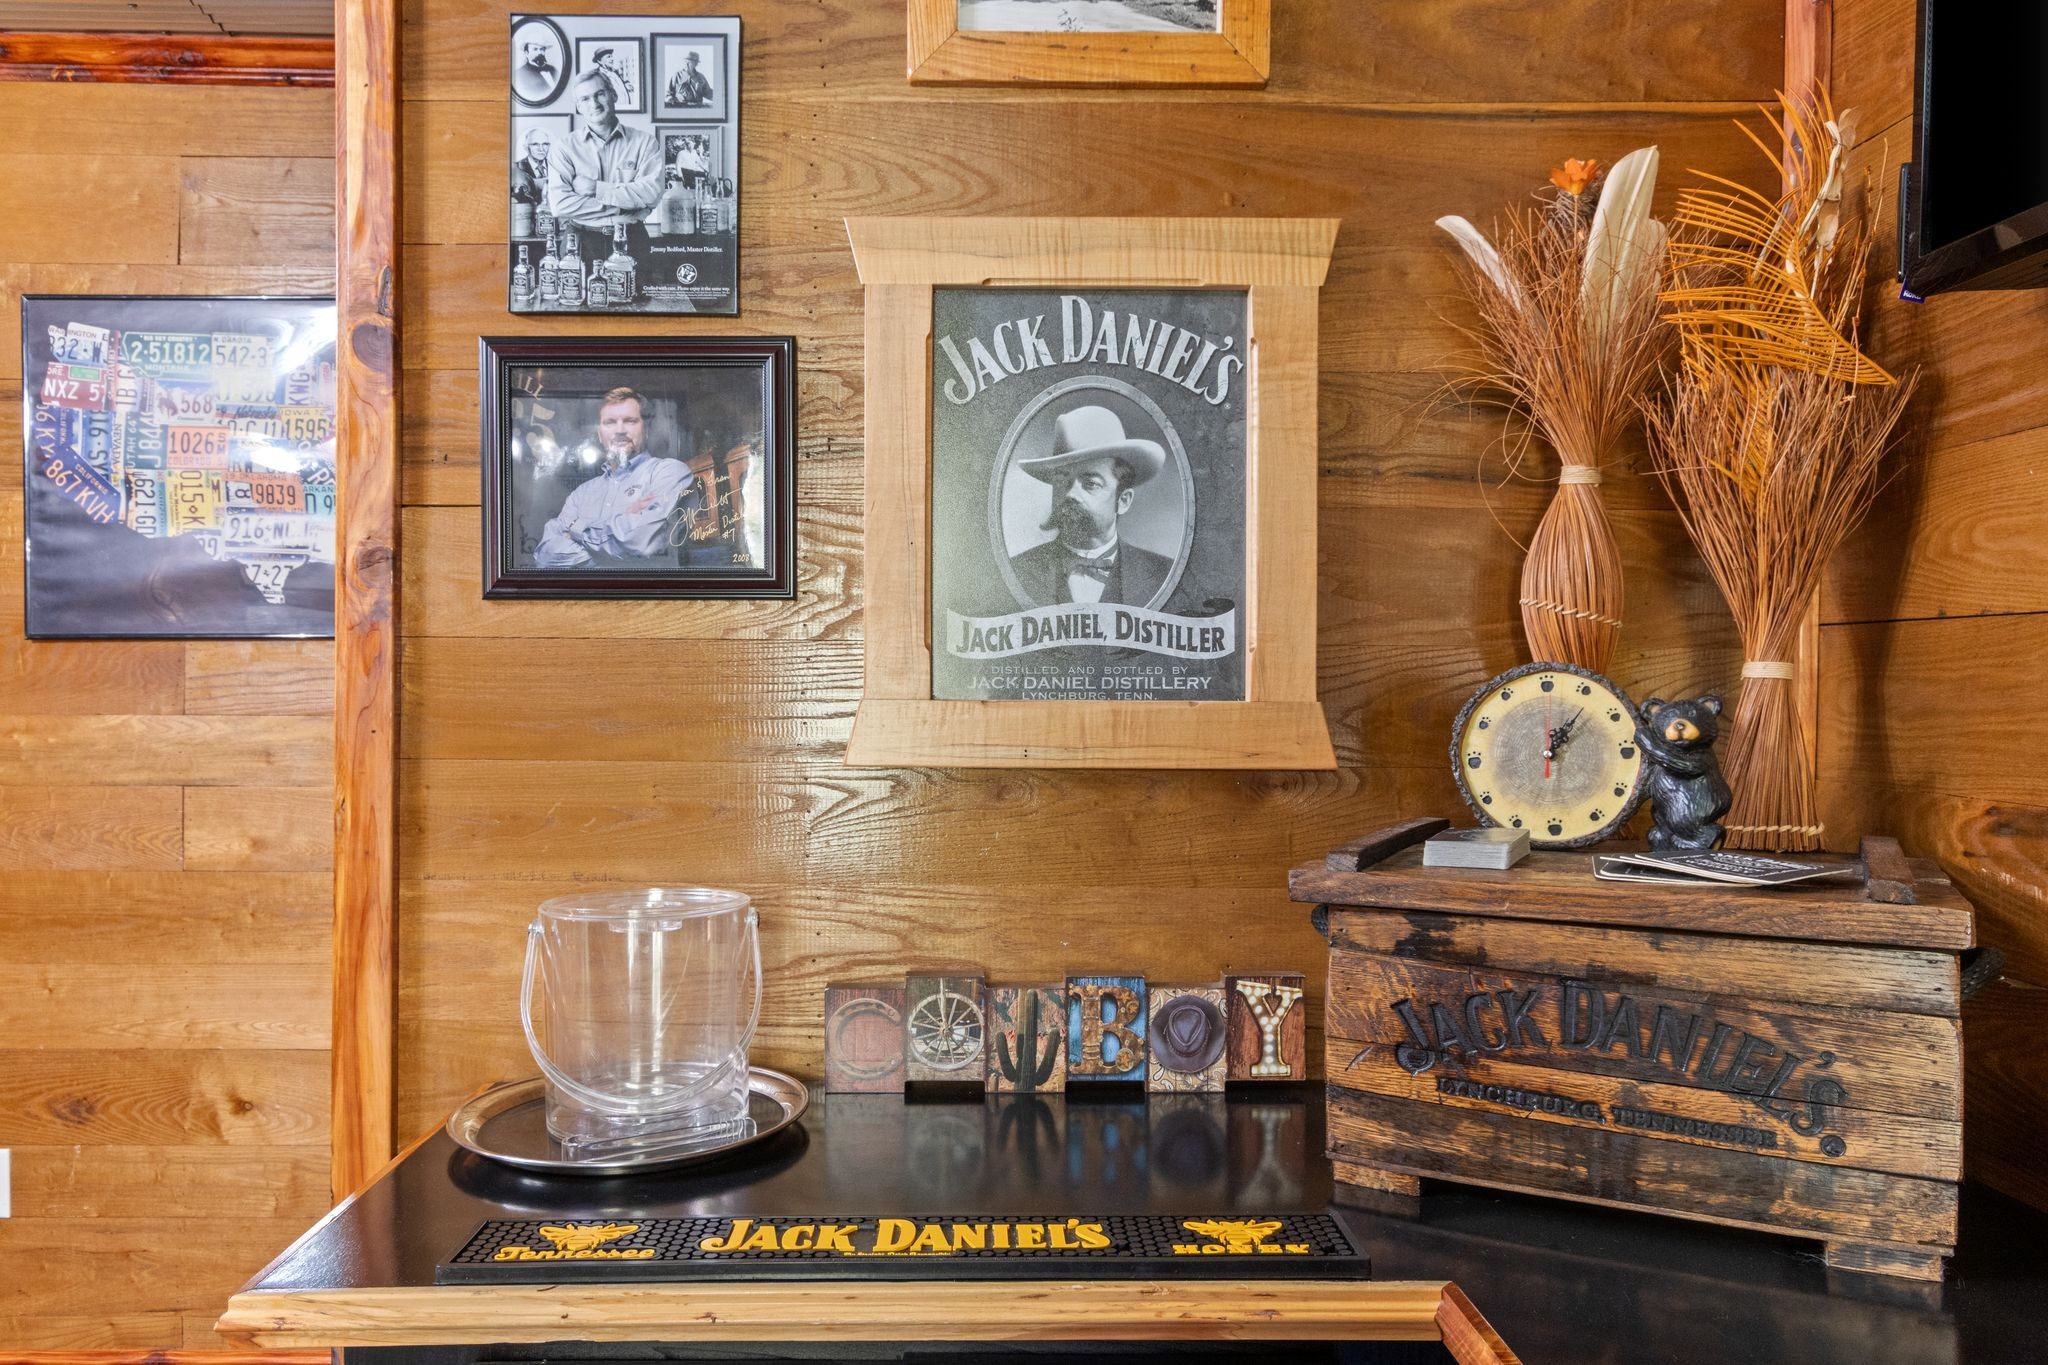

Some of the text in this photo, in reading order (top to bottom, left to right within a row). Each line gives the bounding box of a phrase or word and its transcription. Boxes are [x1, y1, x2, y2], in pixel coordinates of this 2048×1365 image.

[937, 294, 1244, 406] JACK DANIEL'S
[44, 378, 80, 400] NXZ
[169, 431, 215, 454] 1026
[46, 459, 115, 524] 867 KVH
[955, 610, 1226, 654] JACK DANIEL, DISTILLER
[967, 676, 1212, 690] JACK DANIEL DISTILLERY
[991, 666, 1188, 676] DISTILLED AND BOTTLED BY
[1391, 978, 1849, 1137] JACK DANIEL'S
[1611, 1105, 1778, 1150] TENNESSEE
[700, 1218, 1111, 1252] JACK DANIEL'S
[1172, 1244, 1310, 1254] HONEY
[492, 1245, 657, 1261] Tennessee
